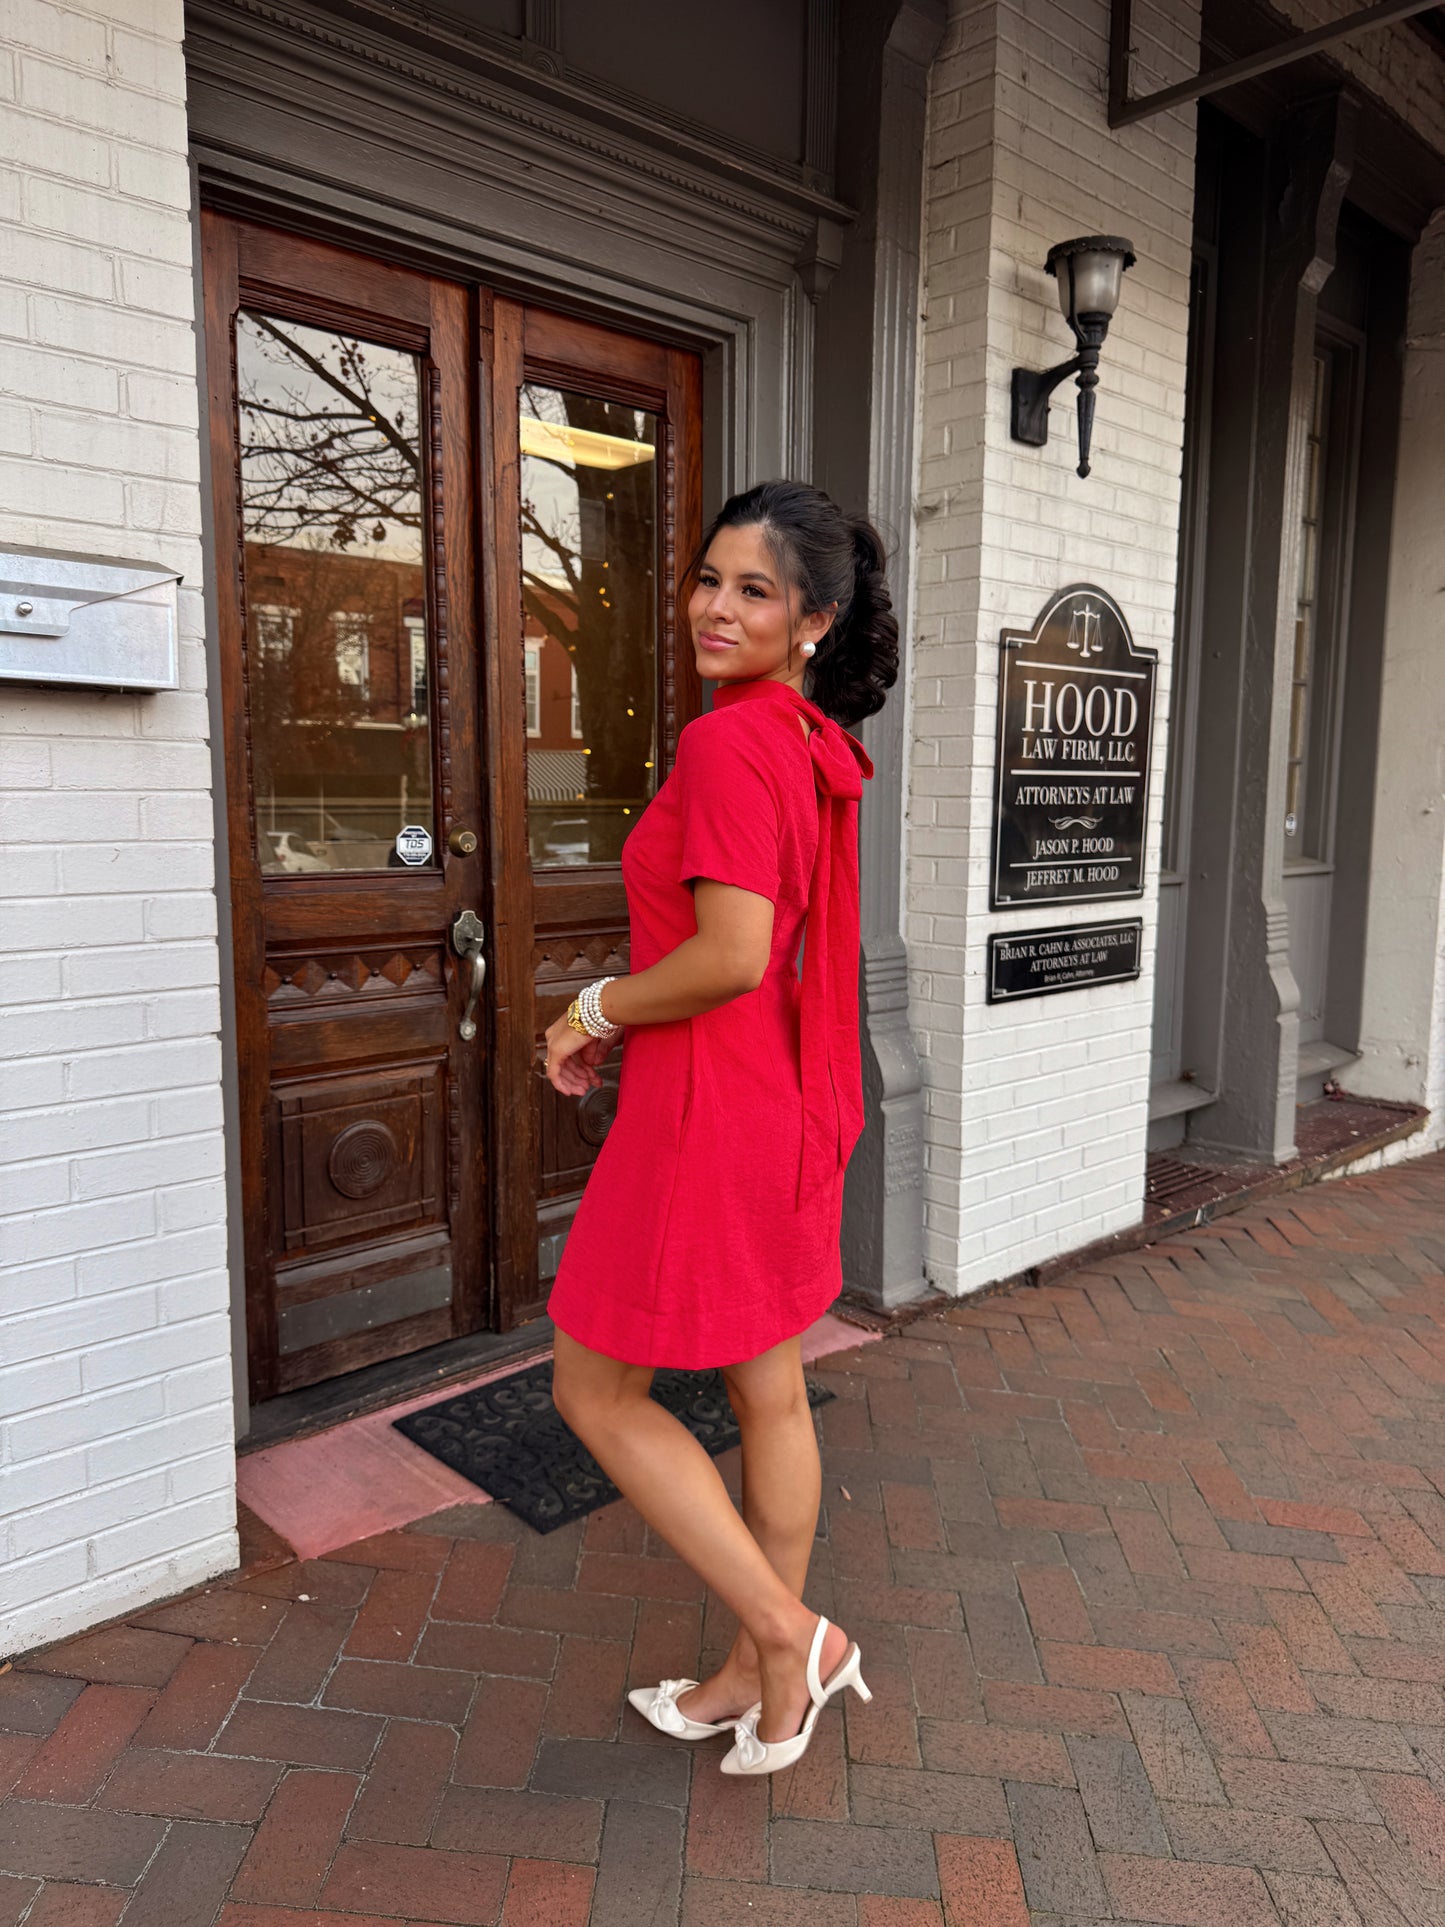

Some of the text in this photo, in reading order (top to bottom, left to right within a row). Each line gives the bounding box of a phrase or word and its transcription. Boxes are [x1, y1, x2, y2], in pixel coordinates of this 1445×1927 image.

[1021, 680, 1138, 737] HOOD
[1022, 737, 1135, 764] LAW FIRM, LLC
[1015, 787, 1134, 805] ATTORNEYS AT LAW
[406, 839, 424, 848] TDS
[1032, 837, 1114, 859] JASON P. HOOD
[1024, 866, 1119, 891] JEFFREY M. HOOD
[1000, 946, 1028, 960] BRIAN
[1039, 942, 1063, 955] CAHN
[1064, 942, 1069, 952] &
[1071, 935, 1119, 950] ASSOCIATES,
[1120, 933, 1134, 944] LLC
[1030, 951, 1108, 972] ATTORNEYS AT LAW
